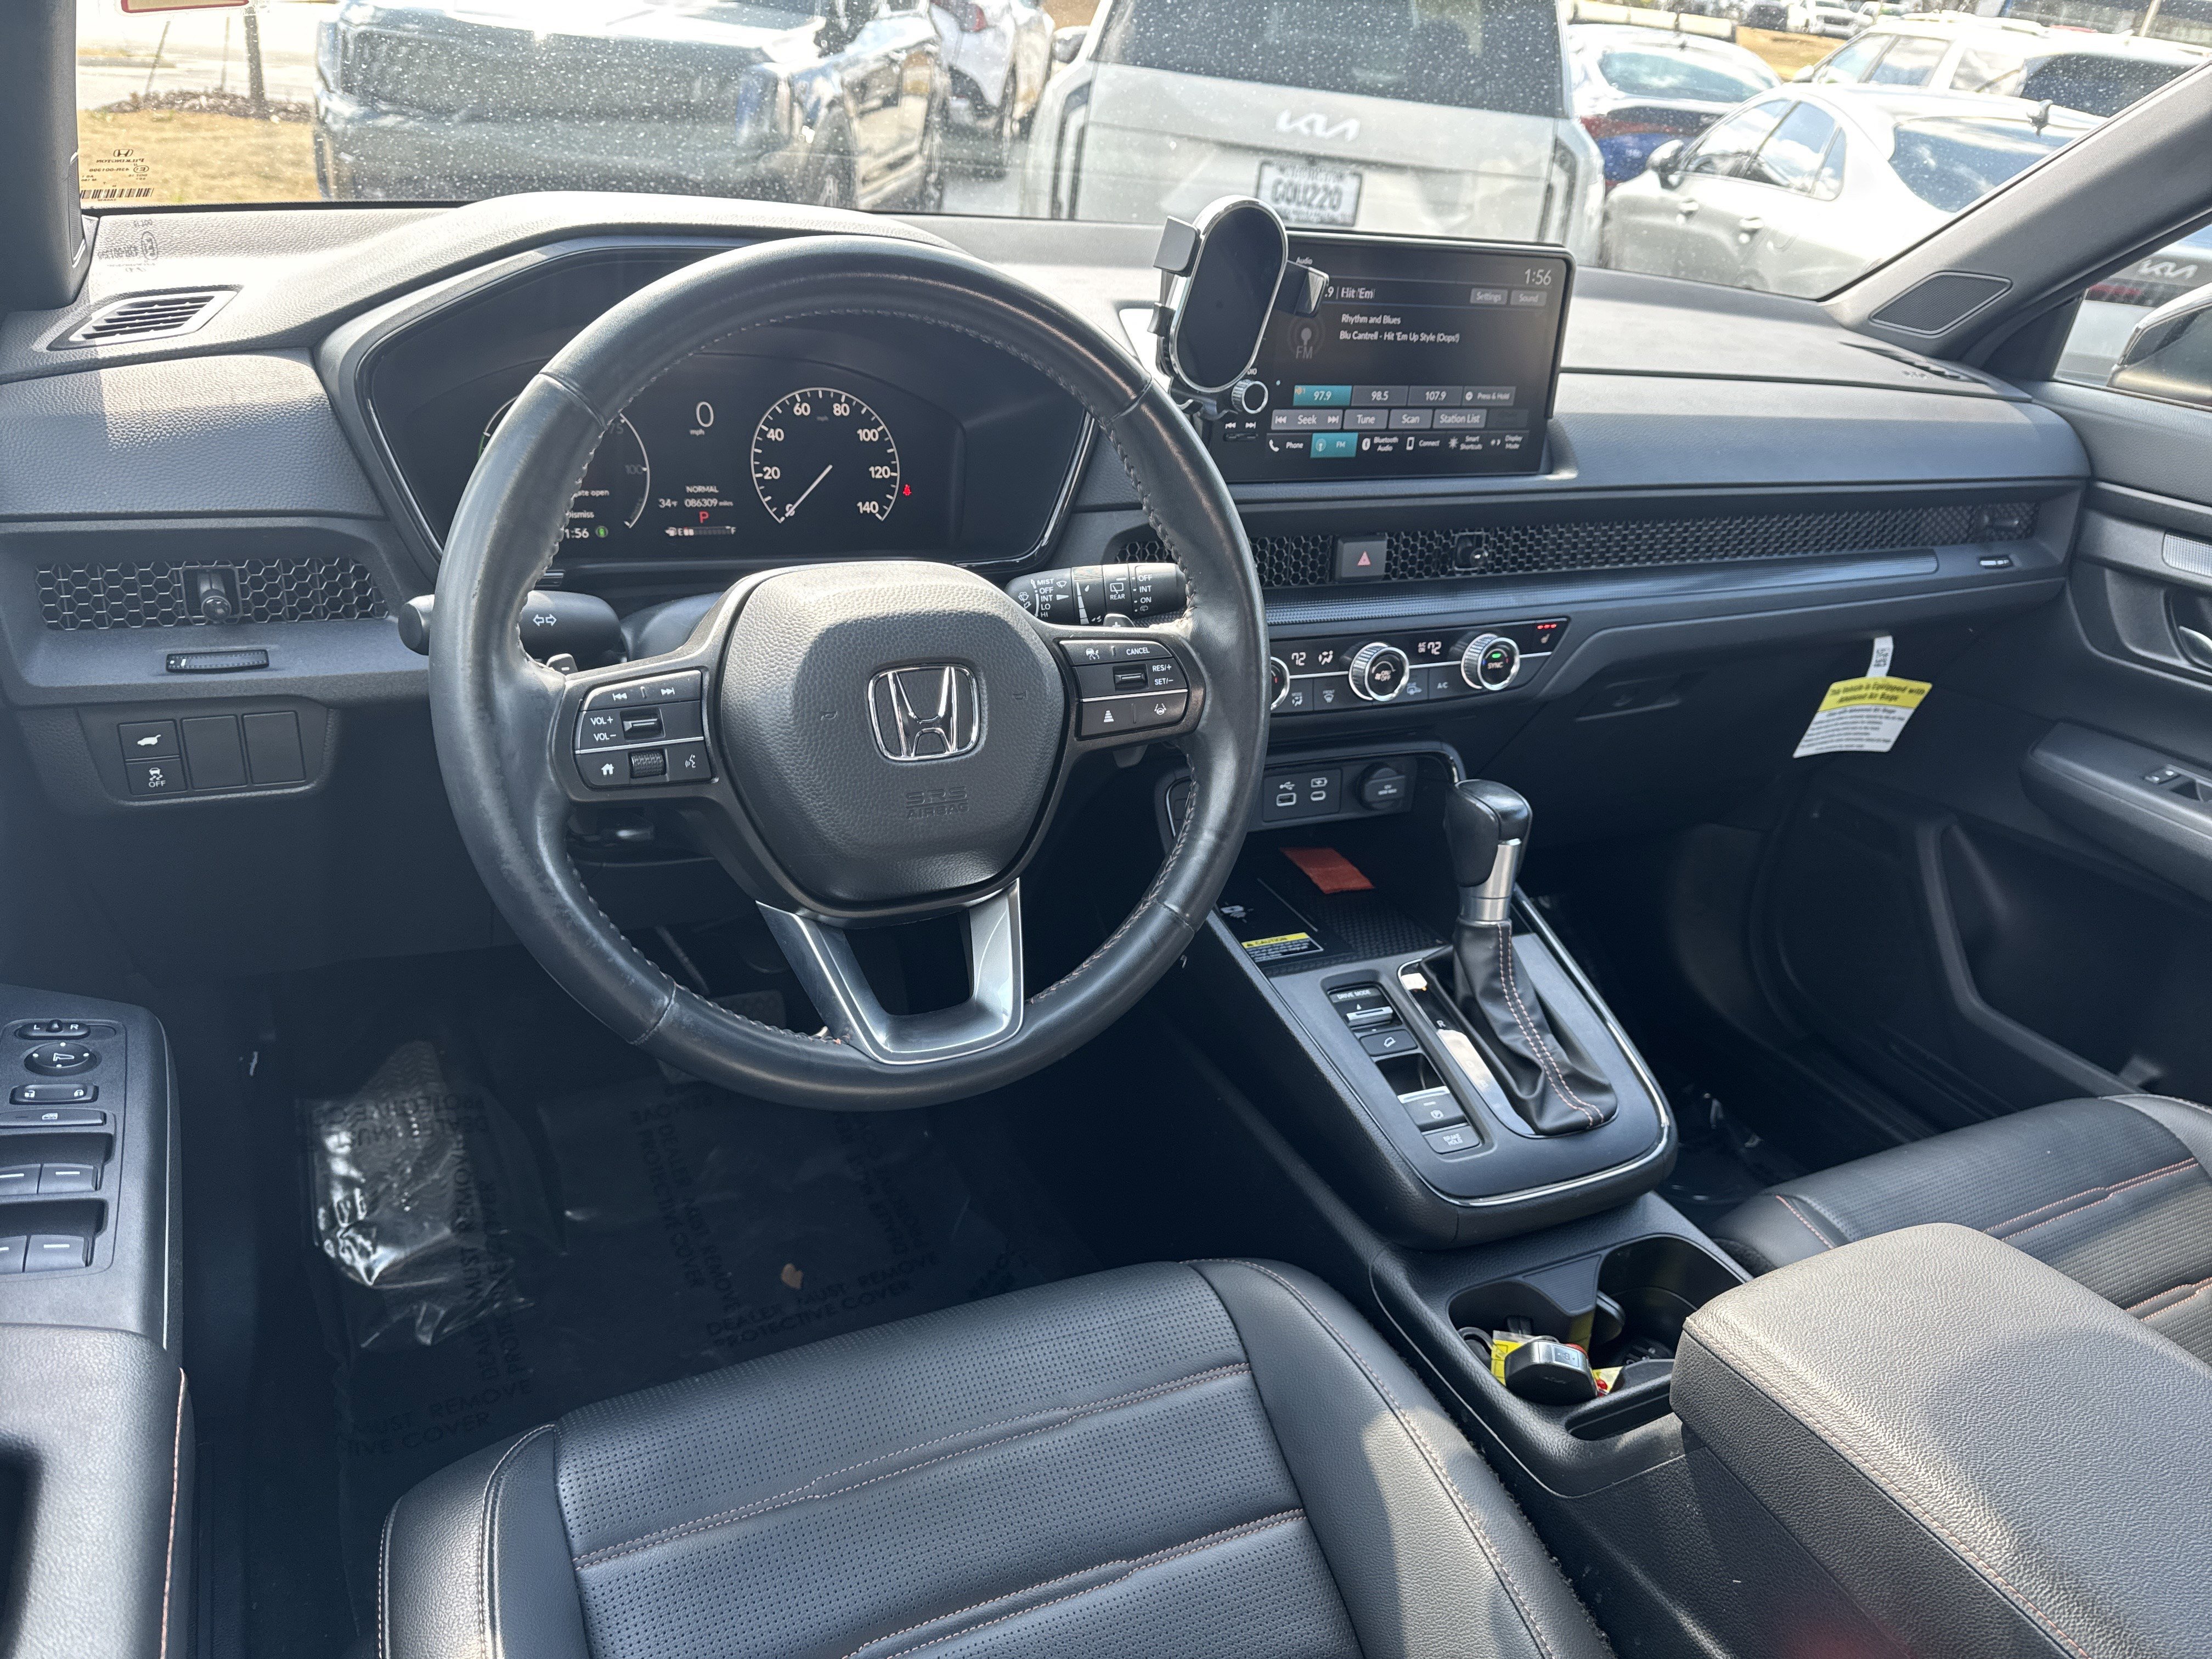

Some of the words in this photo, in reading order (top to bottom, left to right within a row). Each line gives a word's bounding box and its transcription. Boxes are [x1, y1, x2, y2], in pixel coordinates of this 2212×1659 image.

[1525, 268, 1552, 286] 1:56
[1341, 313, 1368, 325] Rhythm
[1369, 314, 1382, 324] and
[1383, 314, 1401, 325] Blues
[1339, 330, 1351, 340] Blu
[1352, 330, 1378, 340] Cantrell
[1384, 331, 1394, 341] Hit
[1409, 332, 1419, 343] Up
[1420, 332, 1435, 343] Style
[1313, 390, 1332, 400] 97.9
[1371, 390, 1389, 402] 98.5
[1425, 390, 1447, 402] 107.9
[696, 402, 714, 427] 0
[793, 402, 811, 416] 60
[833, 403, 850, 416] 80
[1297, 414, 1317, 426] Seek
[1356, 415, 1376, 425] Tune
[1401, 415, 1420, 425] Scan
[1440, 413, 1466, 424] Station
[1467, 413, 1480, 424] List
[766, 428, 785, 441] 40
[857, 428, 879, 442] 100
[763, 466, 781, 480] 20
[868, 466, 891, 479] 120
[686, 485, 719, 493] NORMAL
[685, 498, 718, 508] 086309
[857, 501, 879, 514] 140
[699, 511, 710, 524] P
[1037, 578, 1054, 586] MIST
[1138, 574, 1153, 583] OFF
[1139, 585, 1152, 594] INT
[1040, 594, 1053, 602] INT
[1126, 647, 1150, 656] CANCEL
[1427, 641, 1442, 655] 72
[1291, 652, 1306, 666] 72
[1487, 661, 1504, 670] SYNC
[148, 780, 166, 788] OFF
[1337, 991, 1354, 1000] DRIVE
[1355, 989, 1371, 997] MODE
[428, 1379, 532, 1419] REMOVE
[402, 1412, 490, 1448] COVER
